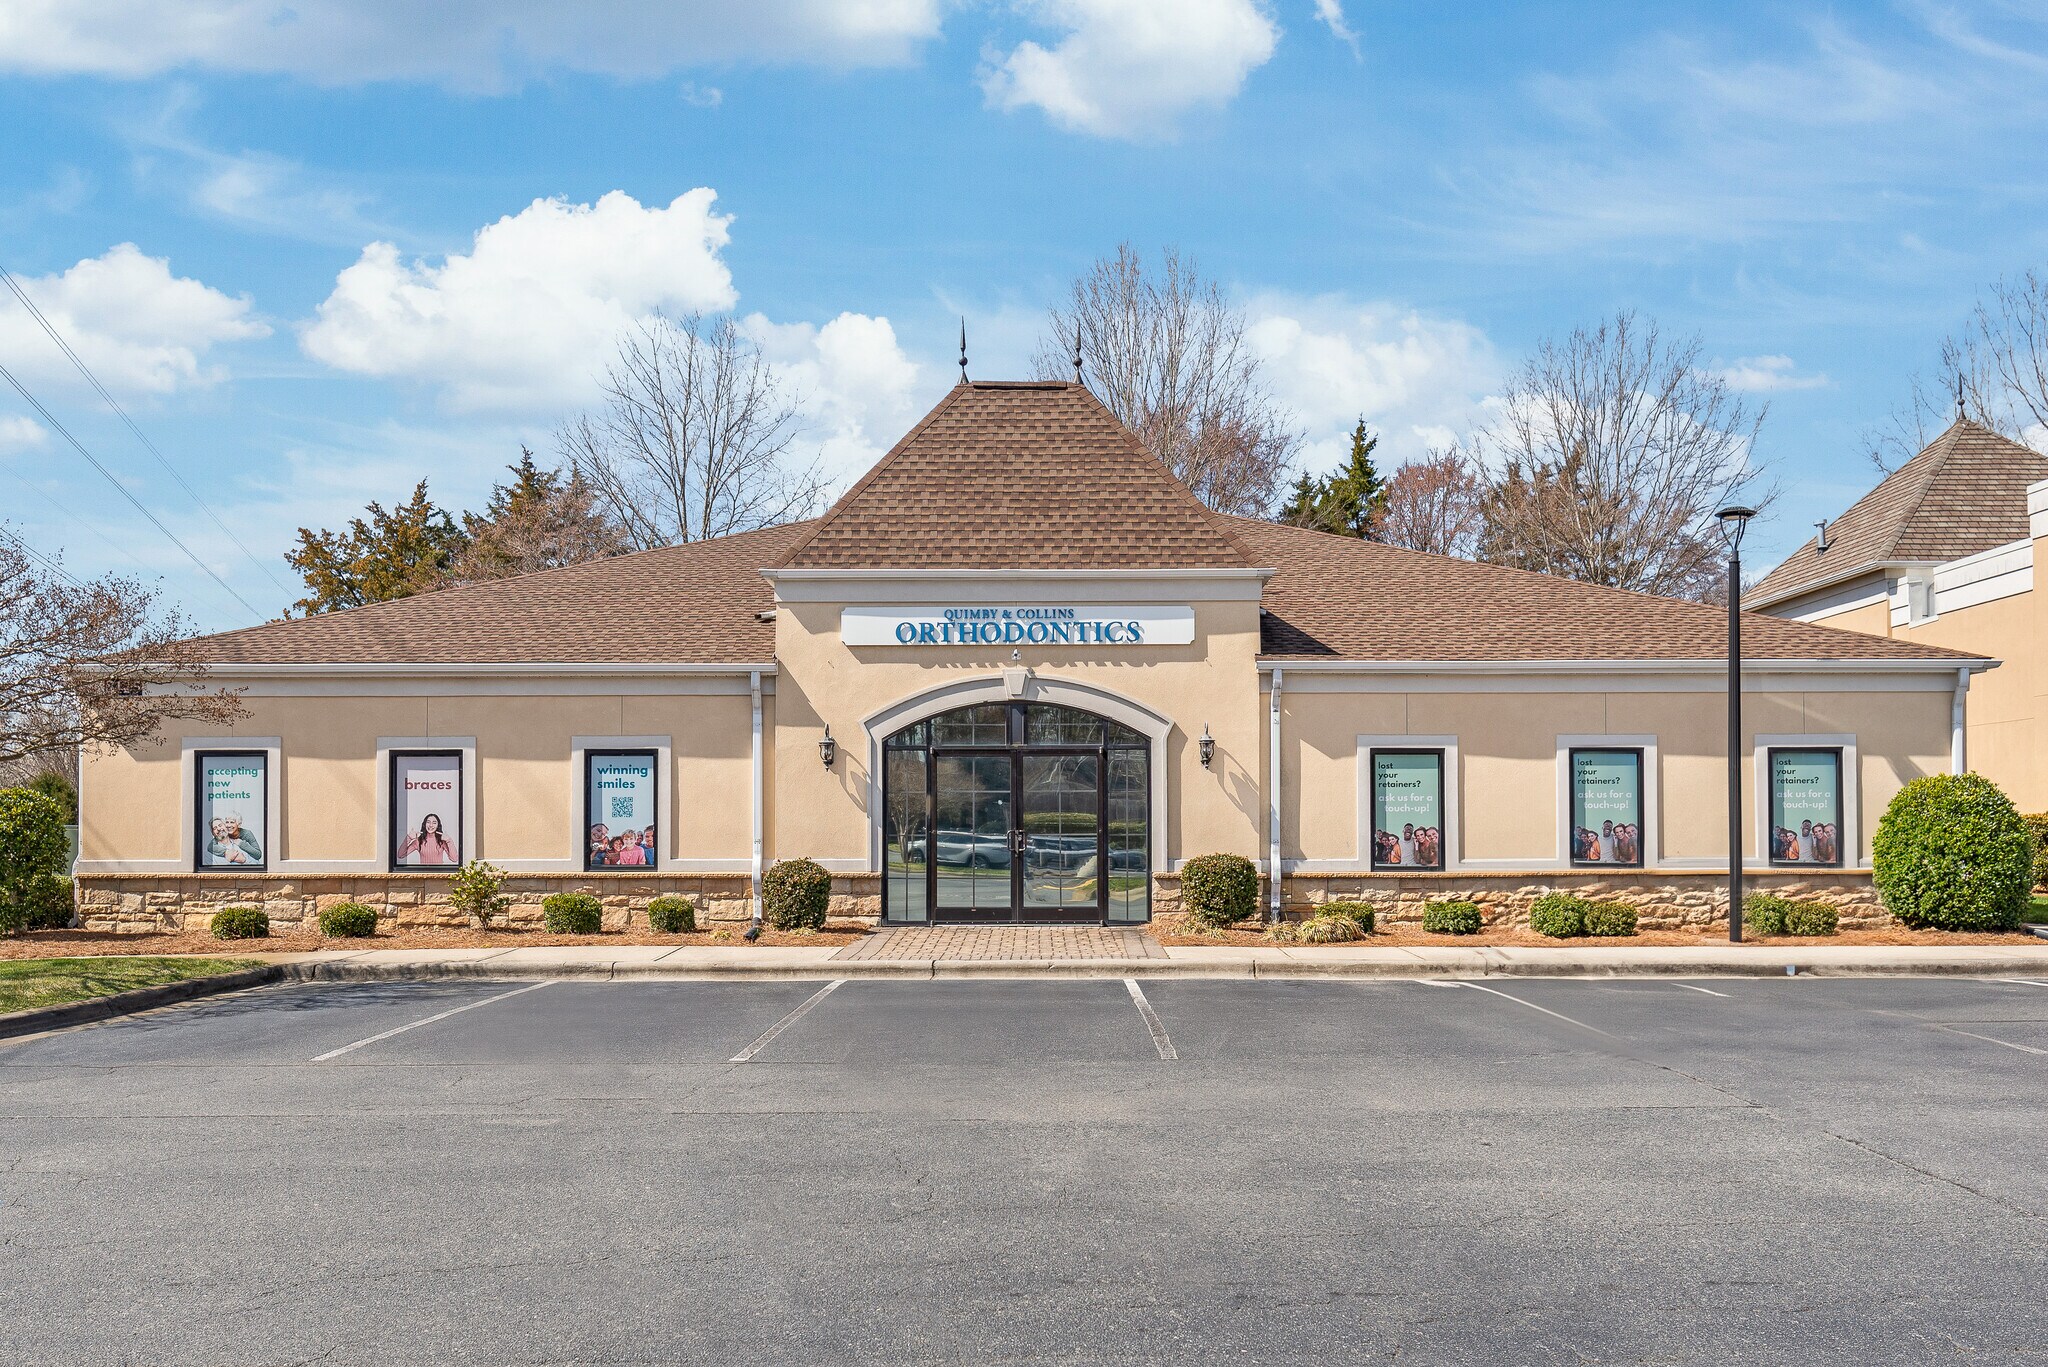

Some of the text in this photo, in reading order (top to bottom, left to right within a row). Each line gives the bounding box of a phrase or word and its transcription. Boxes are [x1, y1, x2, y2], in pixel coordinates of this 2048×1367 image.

[944, 608, 1075, 620] QUIMBY & COLLINS
[894, 621, 1142, 643] ORTHODONTICS
[1776, 758, 1792, 766] lost
[208, 767, 258, 777] accepting
[597, 764, 648, 777] winning
[1577, 769, 1597, 777] your
[1378, 772, 1398, 780] your
[1577, 777, 1620, 785] retainers?
[405, 777, 452, 790] braces
[597, 778, 635, 788] smiles
[1378, 780, 1421, 788] retainers?
[208, 791, 251, 801] patients
[1379, 793, 1395, 802] ask
[1410, 793, 1424, 802] for
[1578, 790, 1594, 798] ask
[1609, 790, 1623, 798] for
[1776, 789, 1793, 798] ask
[1808, 789, 1822, 798] for
[1385, 804, 1430, 814] touch-up!
[1584, 801, 1629, 811] touch-up!
[1783, 800, 1827, 810] touch-up!
